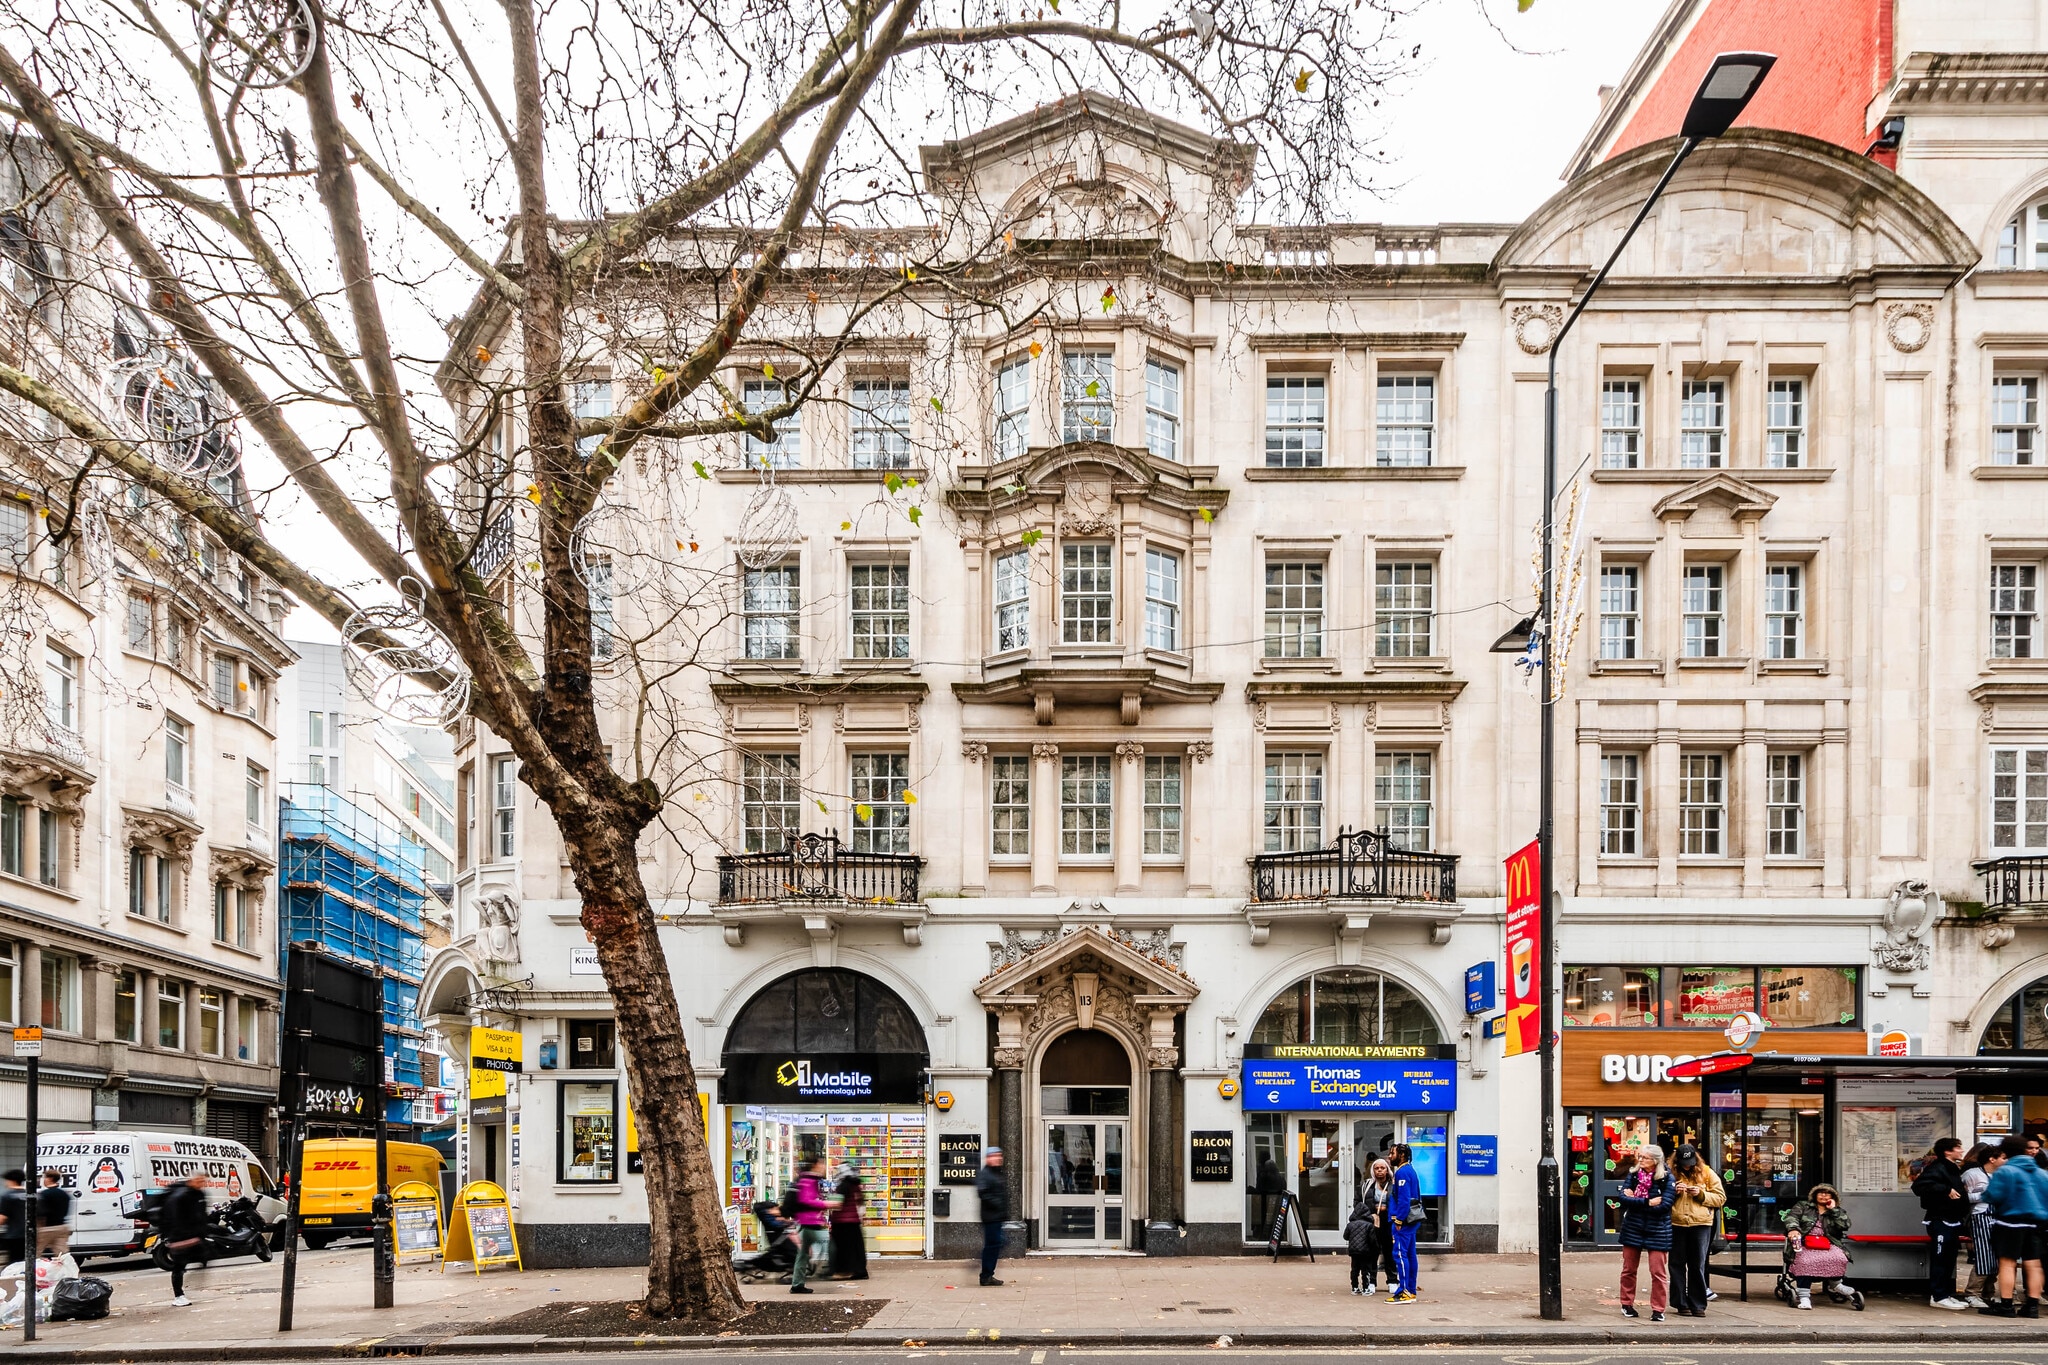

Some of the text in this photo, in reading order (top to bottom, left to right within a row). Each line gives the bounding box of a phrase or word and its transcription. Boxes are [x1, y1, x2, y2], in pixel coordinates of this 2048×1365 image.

[1508, 908, 1520, 923] Next
[1080, 996, 1092, 1006] 113
[486, 1032, 514, 1042] PASSPORT
[1275, 1046, 1425, 1056] INTERNATIONAL PAYMENTS
[486, 1060, 514, 1070] PHOTOS
[1304, 1066, 1361, 1079] Thomas
[814, 1072, 871, 1086] Mobile
[1311, 1080, 1397, 1097] ExchangeUK
[1268, 1090, 1279, 1103] €
[1422, 1090, 1430, 1104] $
[57, 1145, 90, 1154] 3242
[93, 1145, 130, 1154] 8686
[174, 1141, 198, 1155] 0773
[200, 1143, 218, 1157] 242
[219, 1145, 241, 1158] 8686
[941, 1142, 979, 1150] BEACON
[954, 1156, 966, 1164] 113
[1206, 1152, 1218, 1160] 113
[313, 1161, 361, 1171] DHL
[1196, 1166, 1228, 1174] HOUSE
